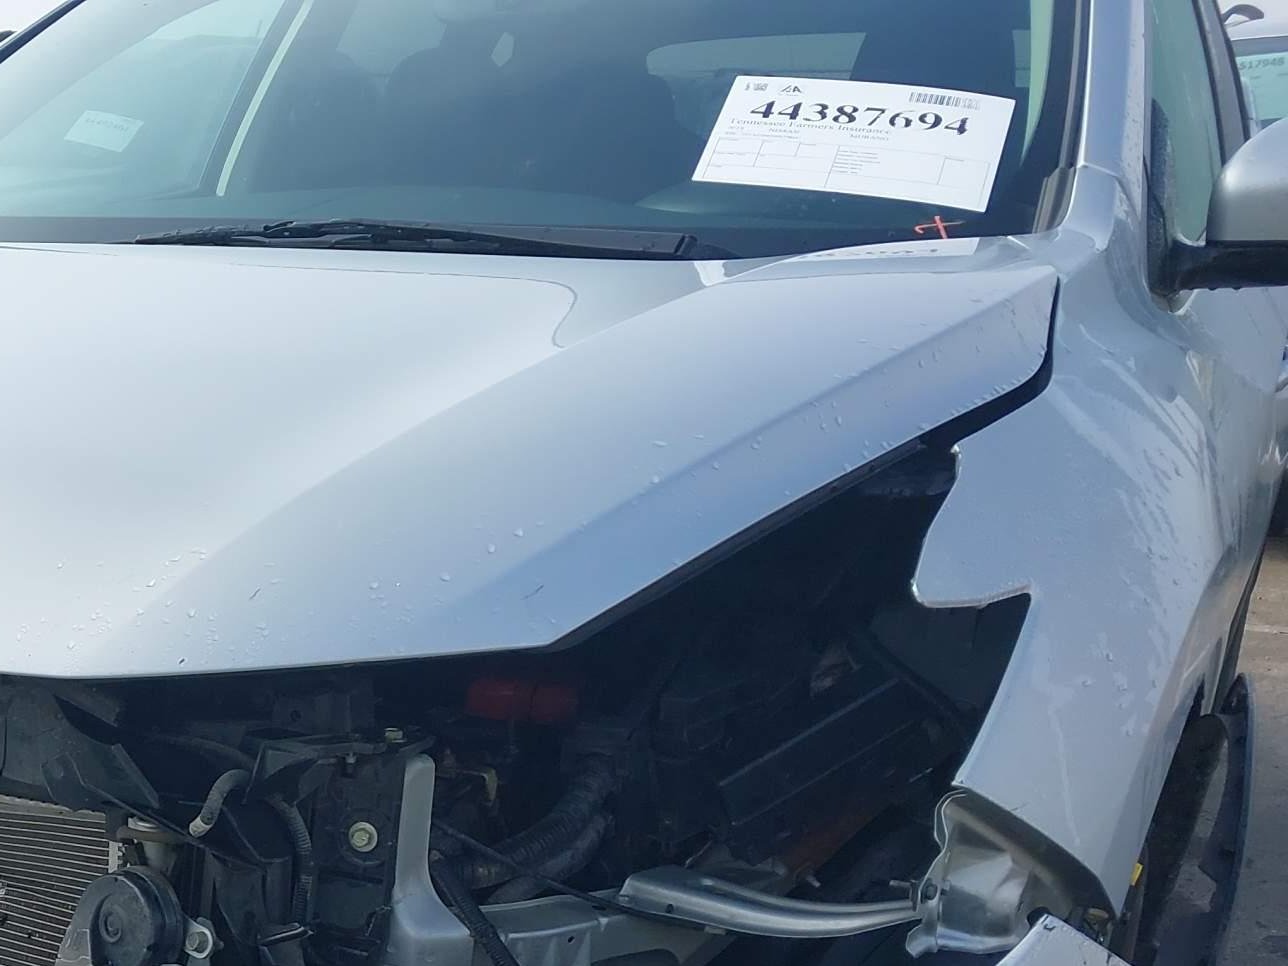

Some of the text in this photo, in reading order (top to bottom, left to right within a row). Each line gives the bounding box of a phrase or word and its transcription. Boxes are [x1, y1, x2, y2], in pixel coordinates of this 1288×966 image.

[730, 117, 891, 134] Tennessee Farmers Insurance
[750, 100, 970, 136] 44387694
